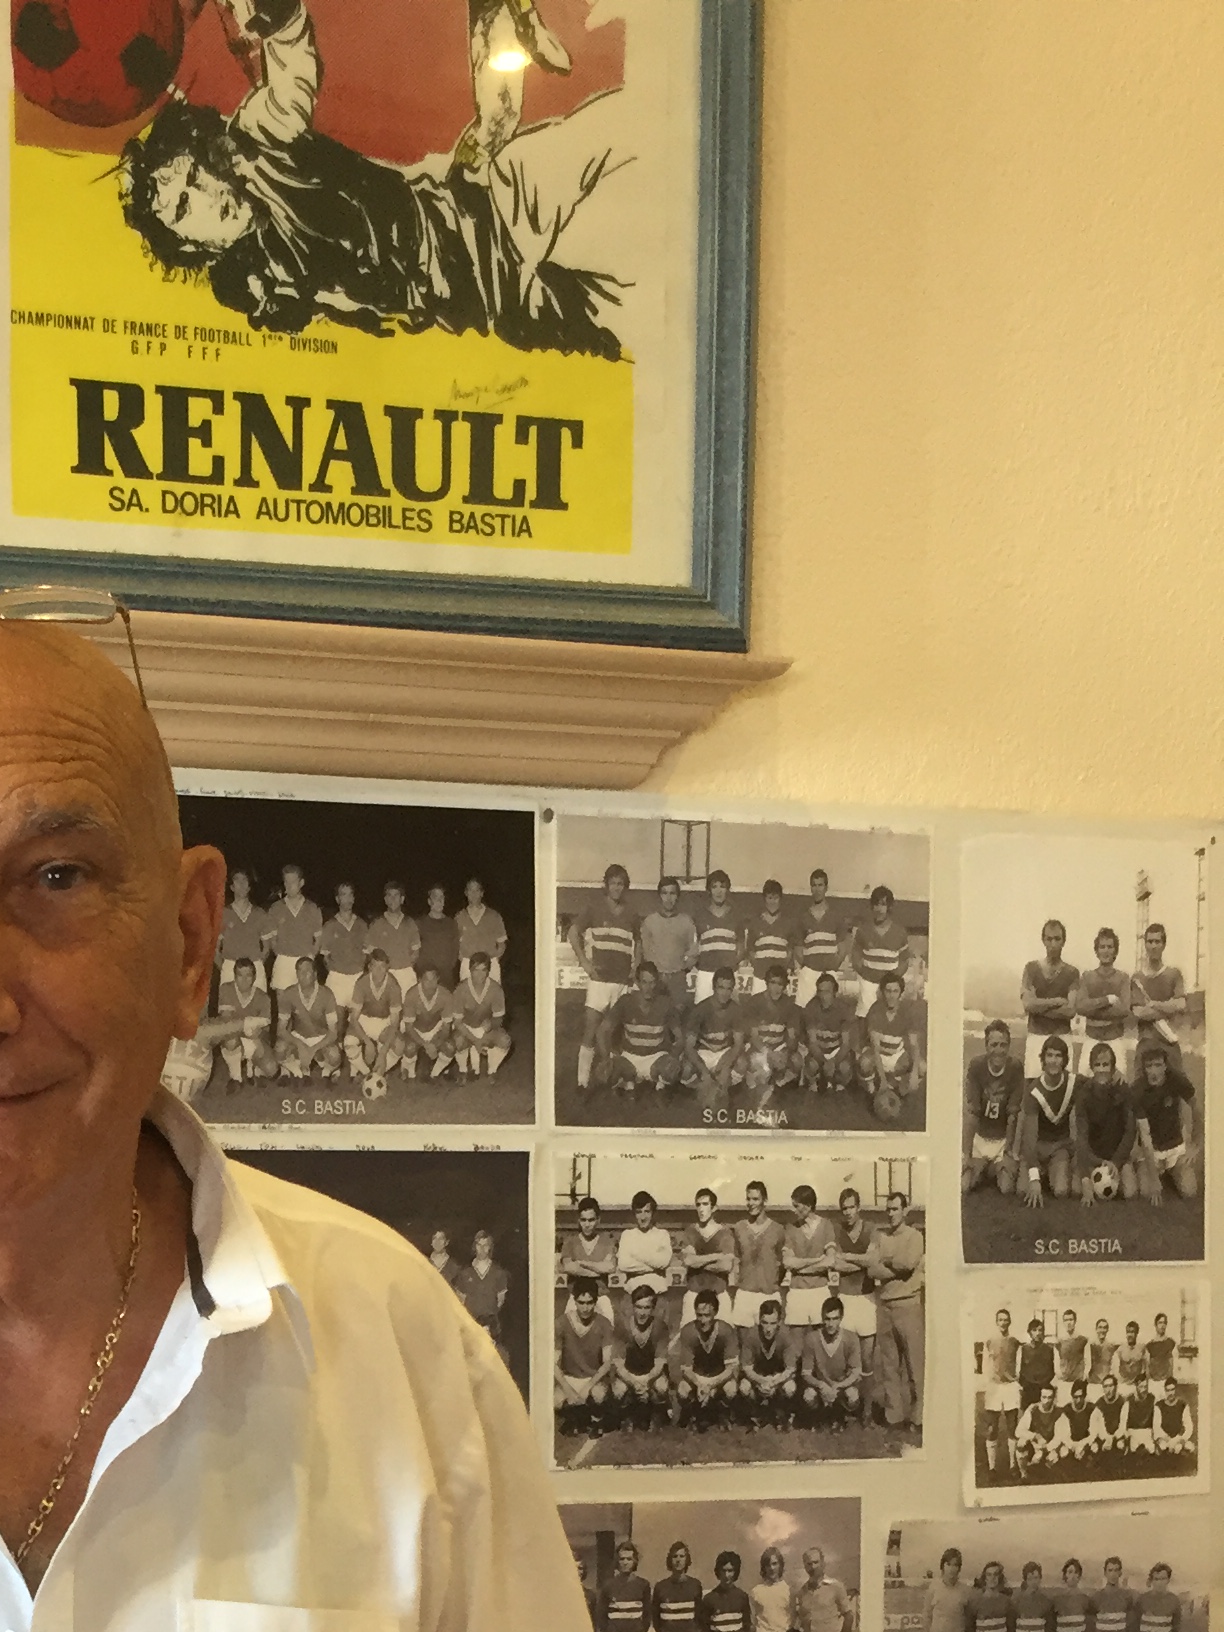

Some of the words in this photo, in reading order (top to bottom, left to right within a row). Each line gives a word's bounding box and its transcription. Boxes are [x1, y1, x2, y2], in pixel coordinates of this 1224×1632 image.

[10, 309, 95, 332] CHAMPIONNAT
[102, 318, 117, 334] DE
[123, 320, 168, 339] FRANCE
[174, 325, 189, 341] DE
[194, 327, 253, 347] FOOTBALL
[289, 336, 339, 354] DIVISION
[69, 378, 584, 511] RENAULT
[108, 486, 150, 514] SA.
[161, 490, 240, 520] DORIA
[256, 497, 433, 533] AUTOMOBILES
[448, 510, 534, 539] BASTIA
[314, 1100, 366, 1116] BASTIA
[736, 1109, 789, 1125] BASTIA
[1068, 1239, 1123, 1255] BASTIA
